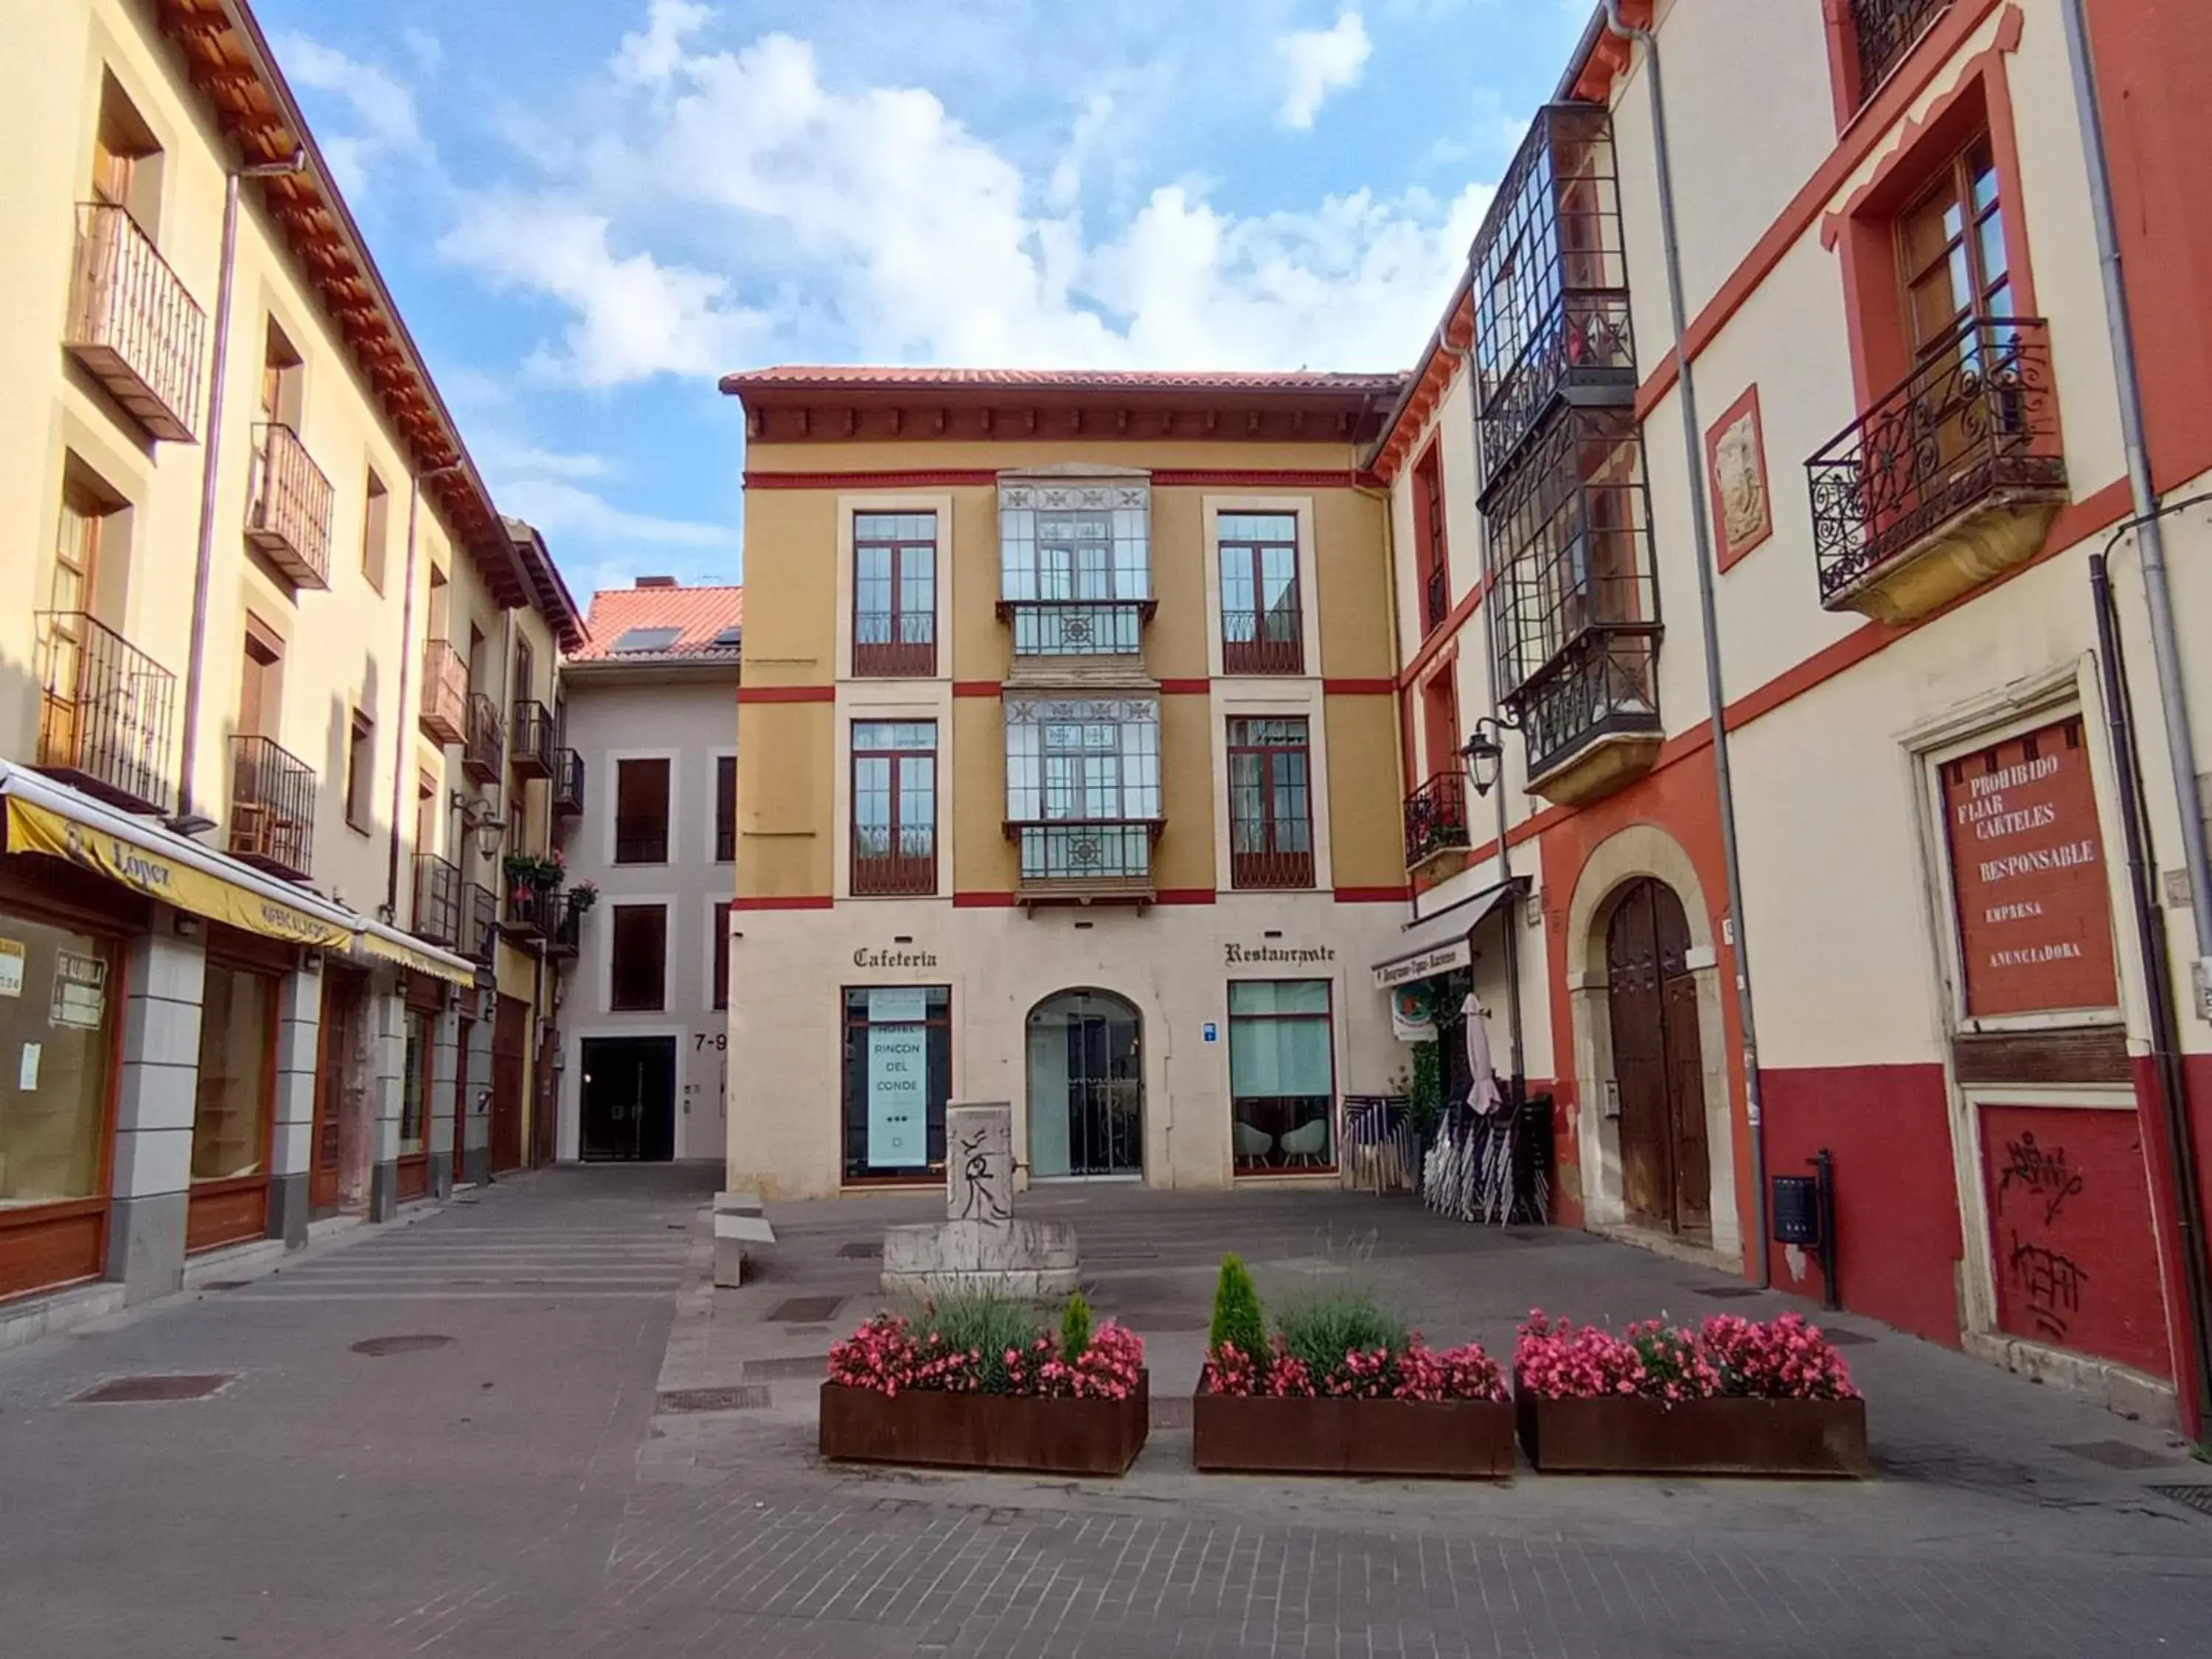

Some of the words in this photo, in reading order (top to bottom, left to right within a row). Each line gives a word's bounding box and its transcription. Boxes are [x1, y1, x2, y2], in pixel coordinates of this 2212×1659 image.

[1971, 755, 2058, 798] PROHIBIDO
[1976, 802, 2055, 840] CARTELES
[1980, 840, 2094, 883] RESPONSABLE
[1985, 902, 2043, 923] EMPRESA
[1224, 943, 1335, 968] Restaurante
[1989, 942, 2082, 968] ANUNCIADORA
[695, 1033, 727, 1051] 7-9
[886, 1062, 908, 1072] DEL
[876, 1080, 917, 1091] CONDE
